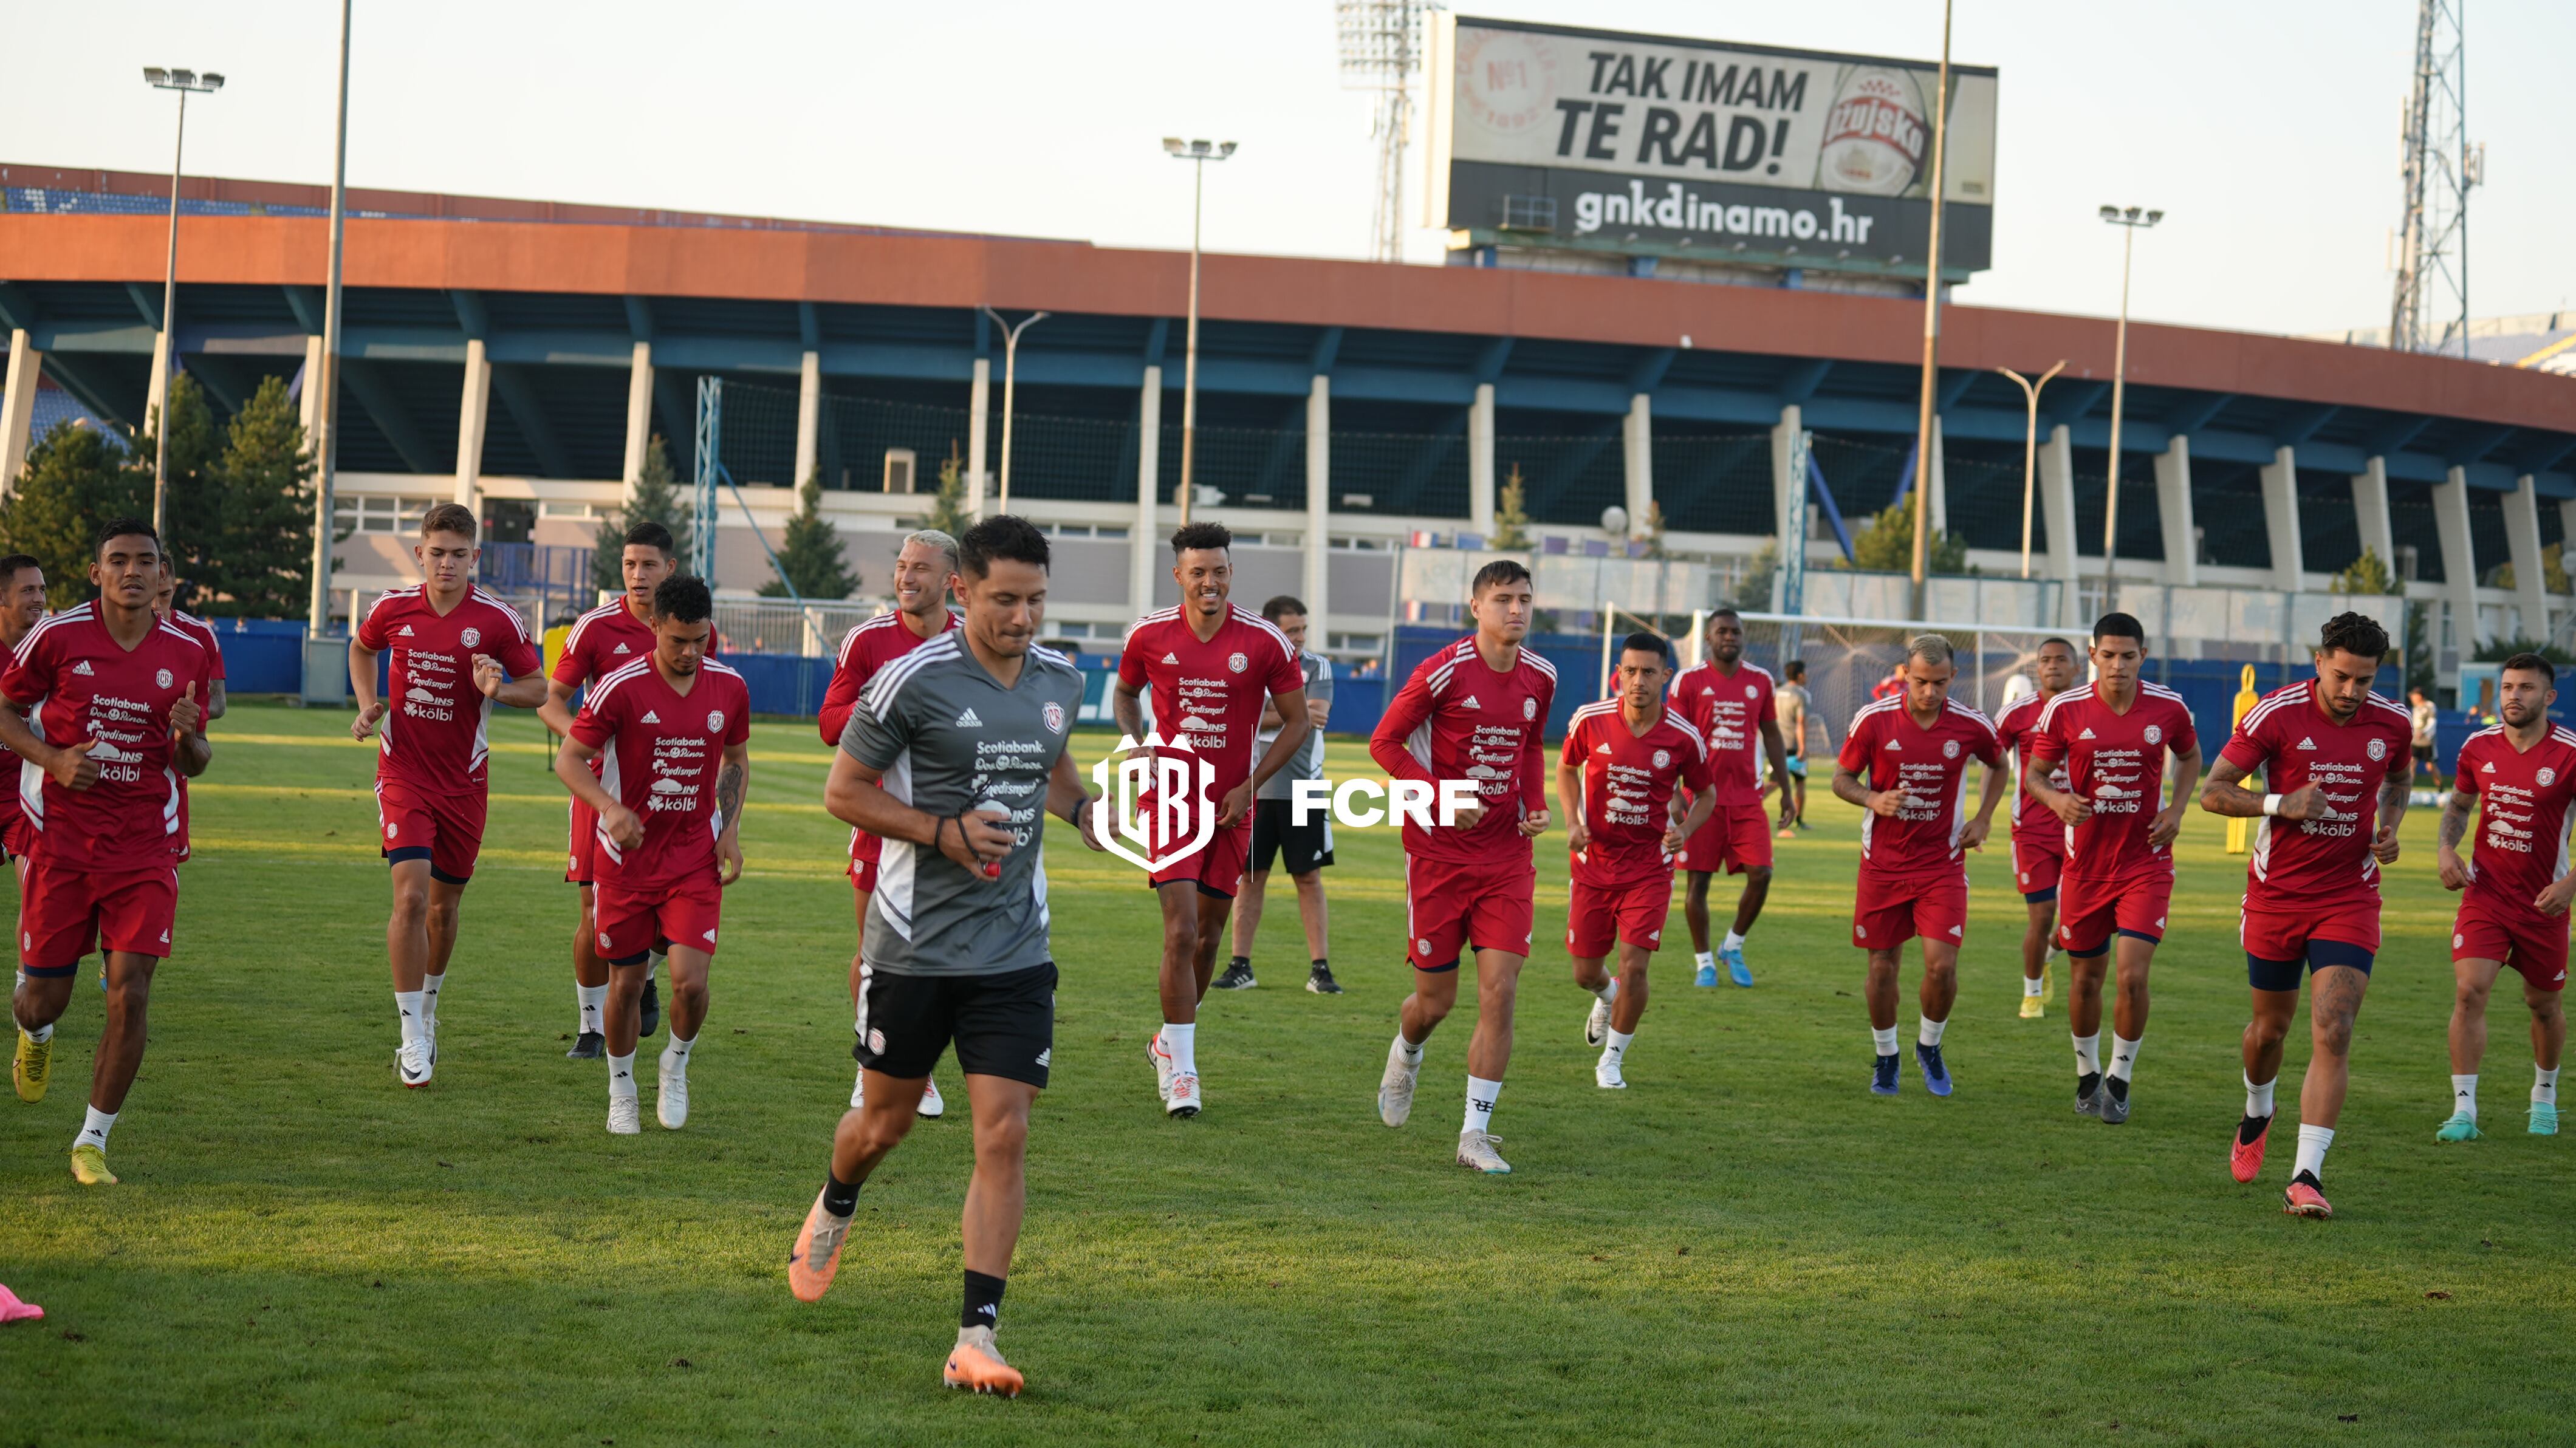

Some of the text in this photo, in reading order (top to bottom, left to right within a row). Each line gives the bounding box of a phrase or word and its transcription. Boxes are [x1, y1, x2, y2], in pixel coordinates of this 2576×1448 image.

[1589, 51, 1674, 98] TAK
[1680, 59, 1808, 112] IMAM
[1556, 98, 1790, 176] TE RAD!
[1575, 179, 1873, 244] gnkdinamo.hr
[413, 678, 453, 689] medismart
[434, 697, 454, 706] INS
[419, 705, 453, 721] kölbi
[1187, 705, 1225, 715] medismart
[95, 729, 142, 744] medismart
[1194, 734, 1226, 748] kölbi
[121, 751, 143, 762] INS
[100, 763, 140, 782] kölbi
[1496, 770, 1512, 779] INS
[2335, 774, 2363, 784] Pinos
[682, 784, 700, 794] INS
[1478, 782, 1509, 795] kölbi
[665, 797, 697, 811] kölbi
[2326, 792, 2358, 804] dismart
[1012, 808, 1035, 822] INS
[1619, 813, 1649, 825] kölbi
[2318, 822, 2355, 836] kölbi
[2514, 830, 2533, 838] INS
[2501, 837, 2532, 852] kölbi
